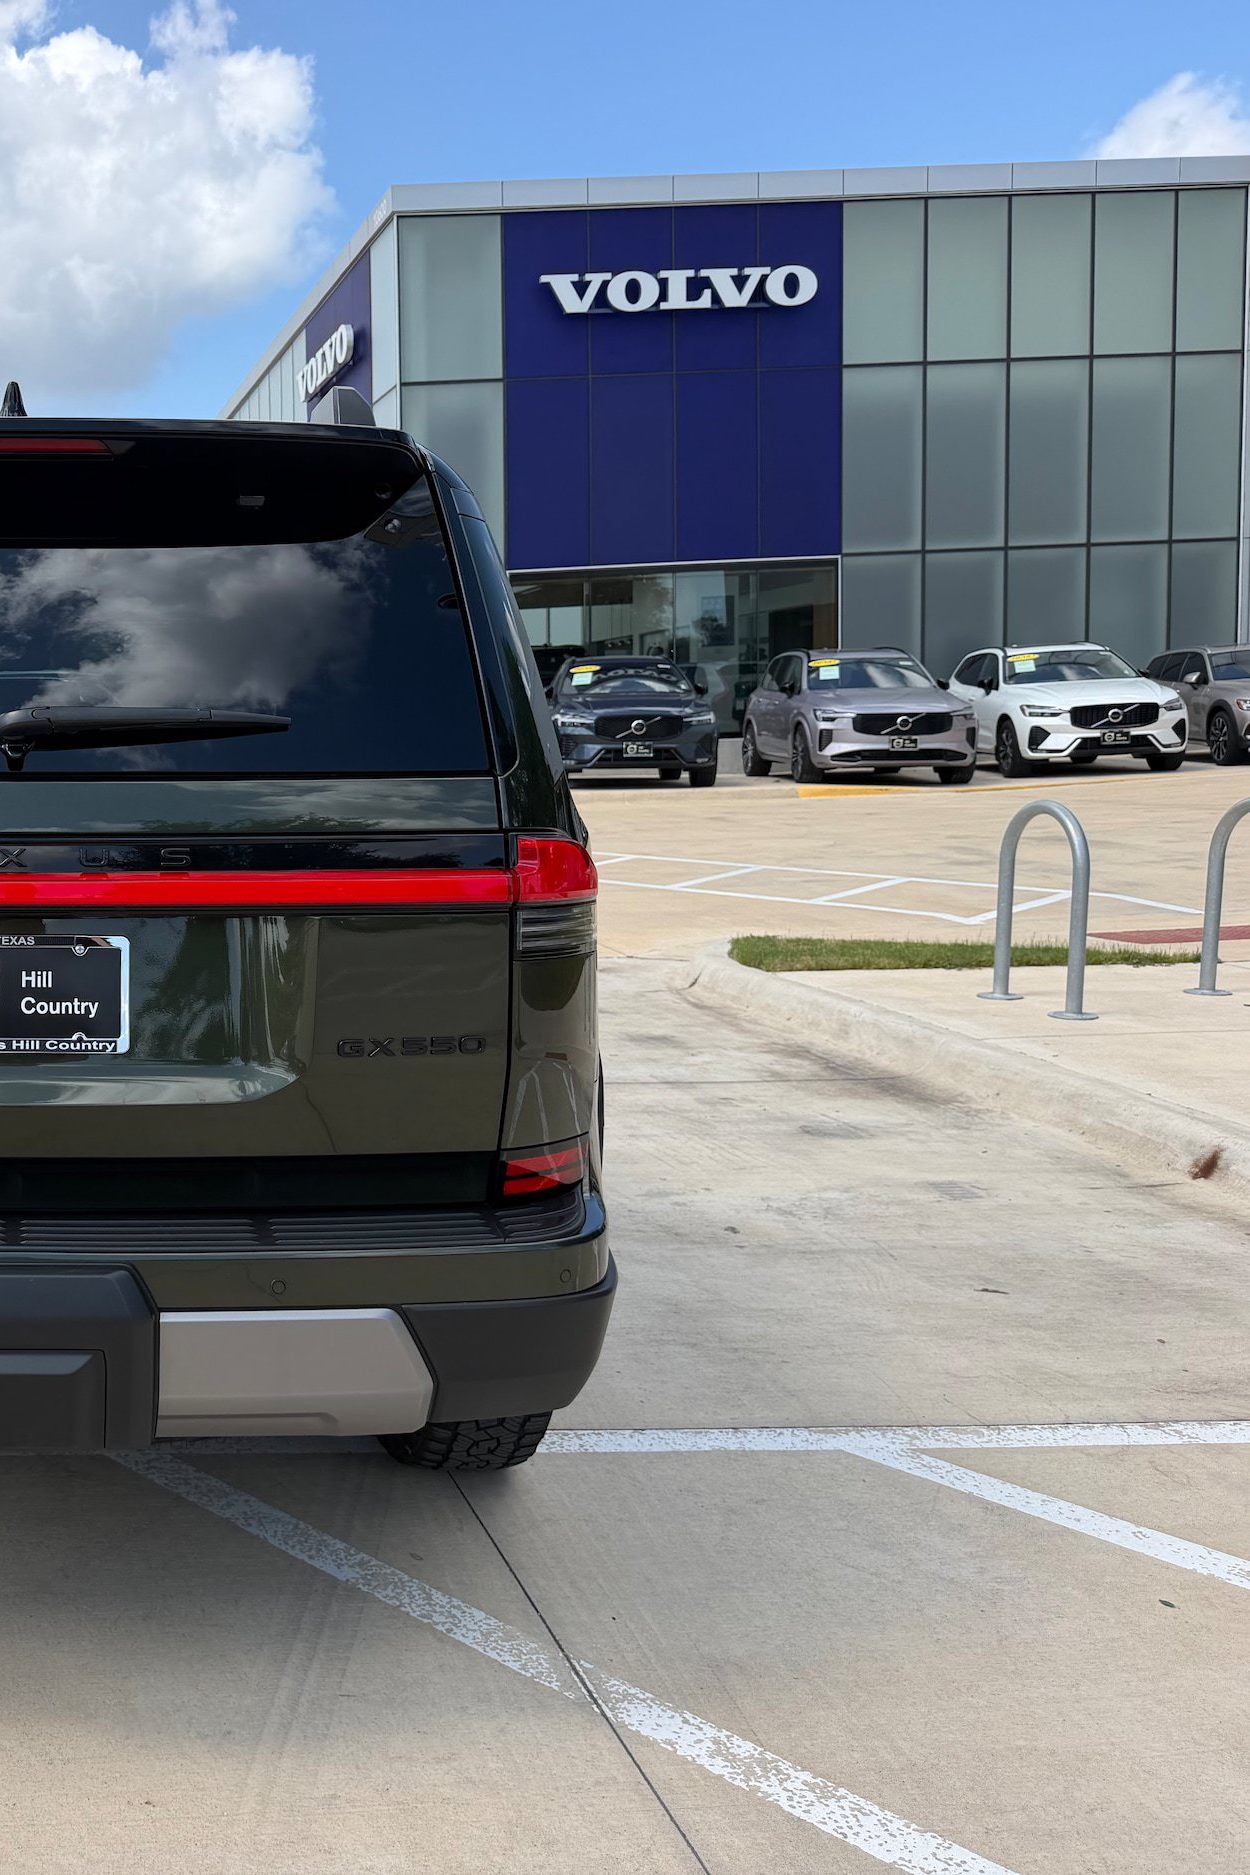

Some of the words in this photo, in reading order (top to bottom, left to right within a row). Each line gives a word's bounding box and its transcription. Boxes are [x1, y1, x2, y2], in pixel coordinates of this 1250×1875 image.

[539, 265, 818, 315] VOLVO
[297, 324, 354, 403] VOLVO
[21, 971, 53, 988] Hill
[20, 997, 99, 1018] Country
[12, 1040, 40, 1051] Hill
[45, 1040, 116, 1052] Country
